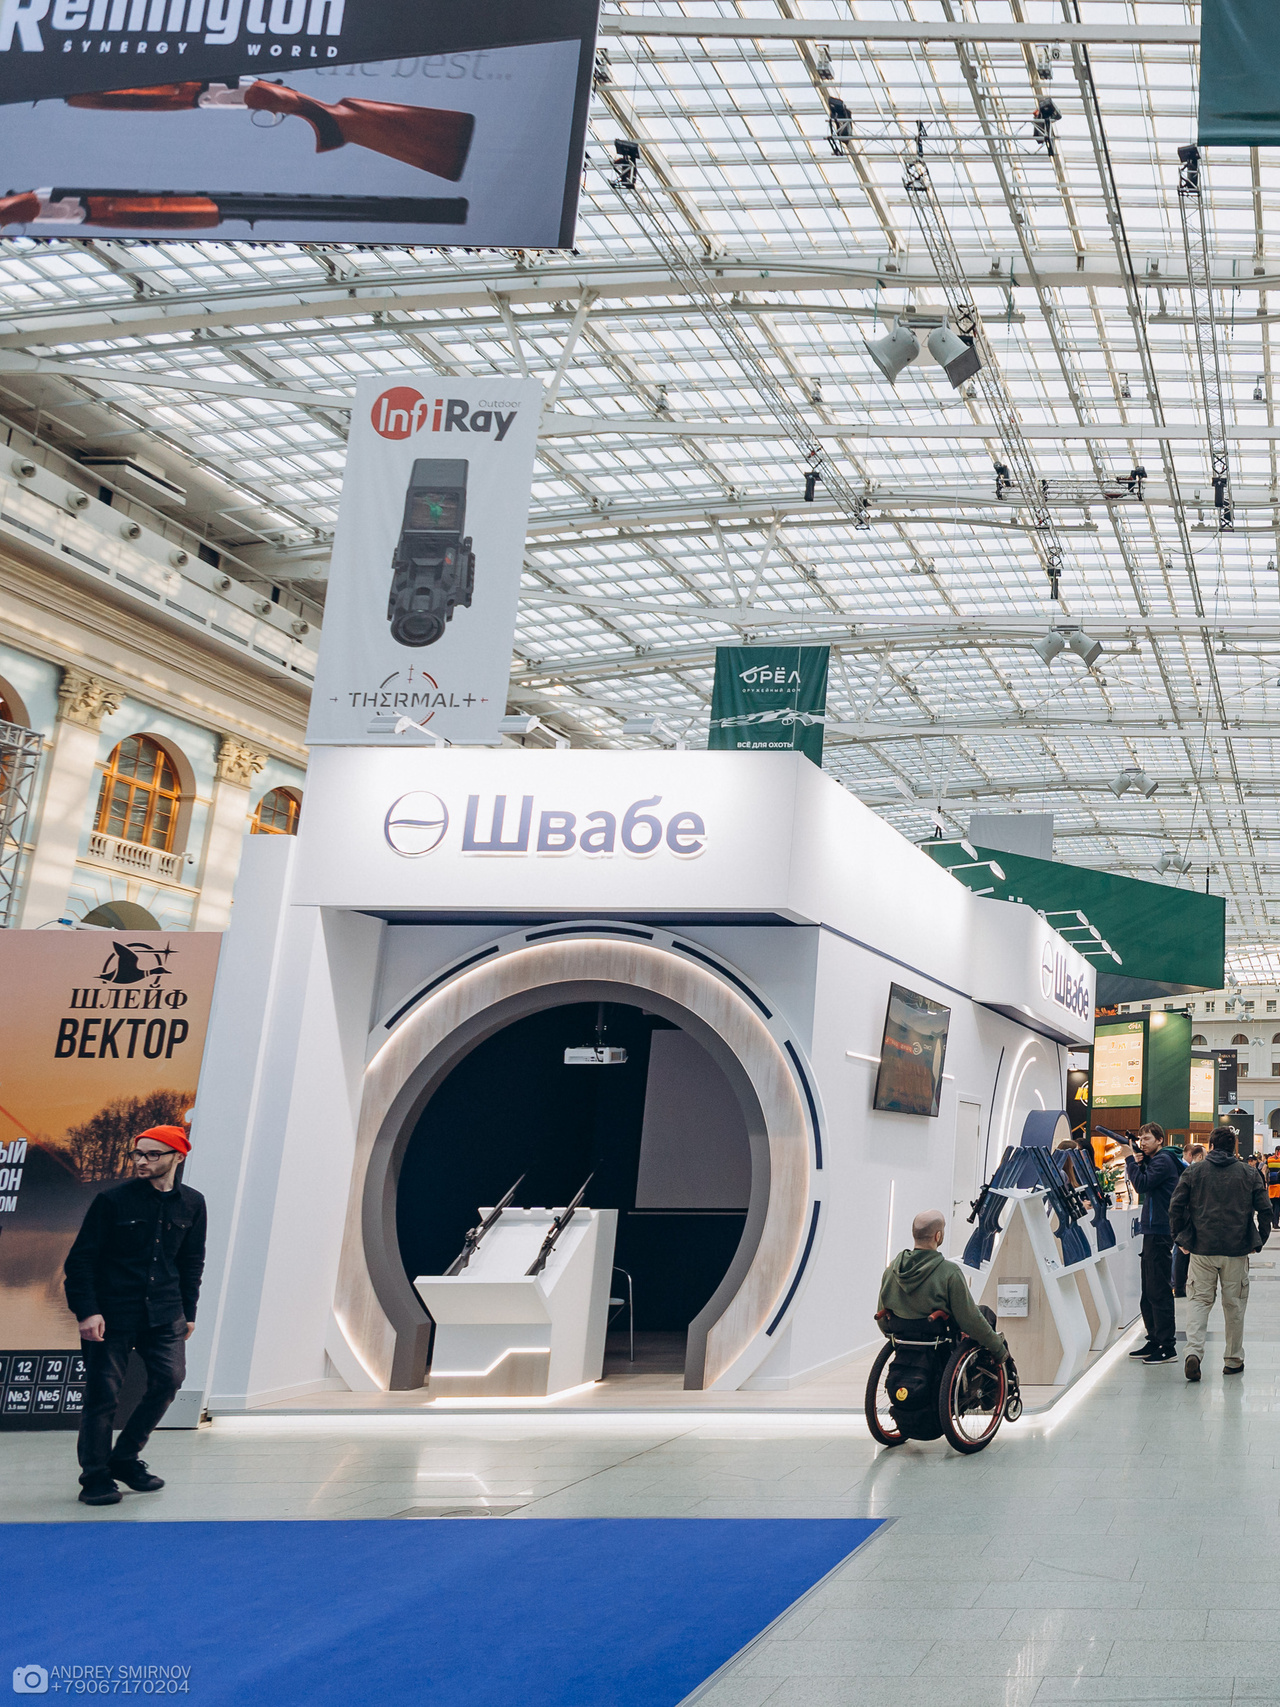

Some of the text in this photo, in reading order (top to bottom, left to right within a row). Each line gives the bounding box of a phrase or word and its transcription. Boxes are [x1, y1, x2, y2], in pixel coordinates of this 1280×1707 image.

[0, 0, 345, 52] Remington
[62, 40, 339, 58] SYNERGY WORLD
[478, 398, 522, 408] Outdoor
[378, 397, 518, 442] InfiRay
[739, 664, 801, 684] ОРЁЛ
[461, 792, 708, 857] Швабе
[1054, 951, 1089, 1021] Швабе
[68, 982, 189, 1011] ШЛЕЙФ
[54, 1017, 189, 1059] ВЕКТОР
[17, 1361, 33, 1373] 12
[46, 1360, 63, 1373] 70
[75, 1360, 87, 1373] 3.
[7, 1390, 31, 1402] №3
[37, 1389, 60, 1402] №5
